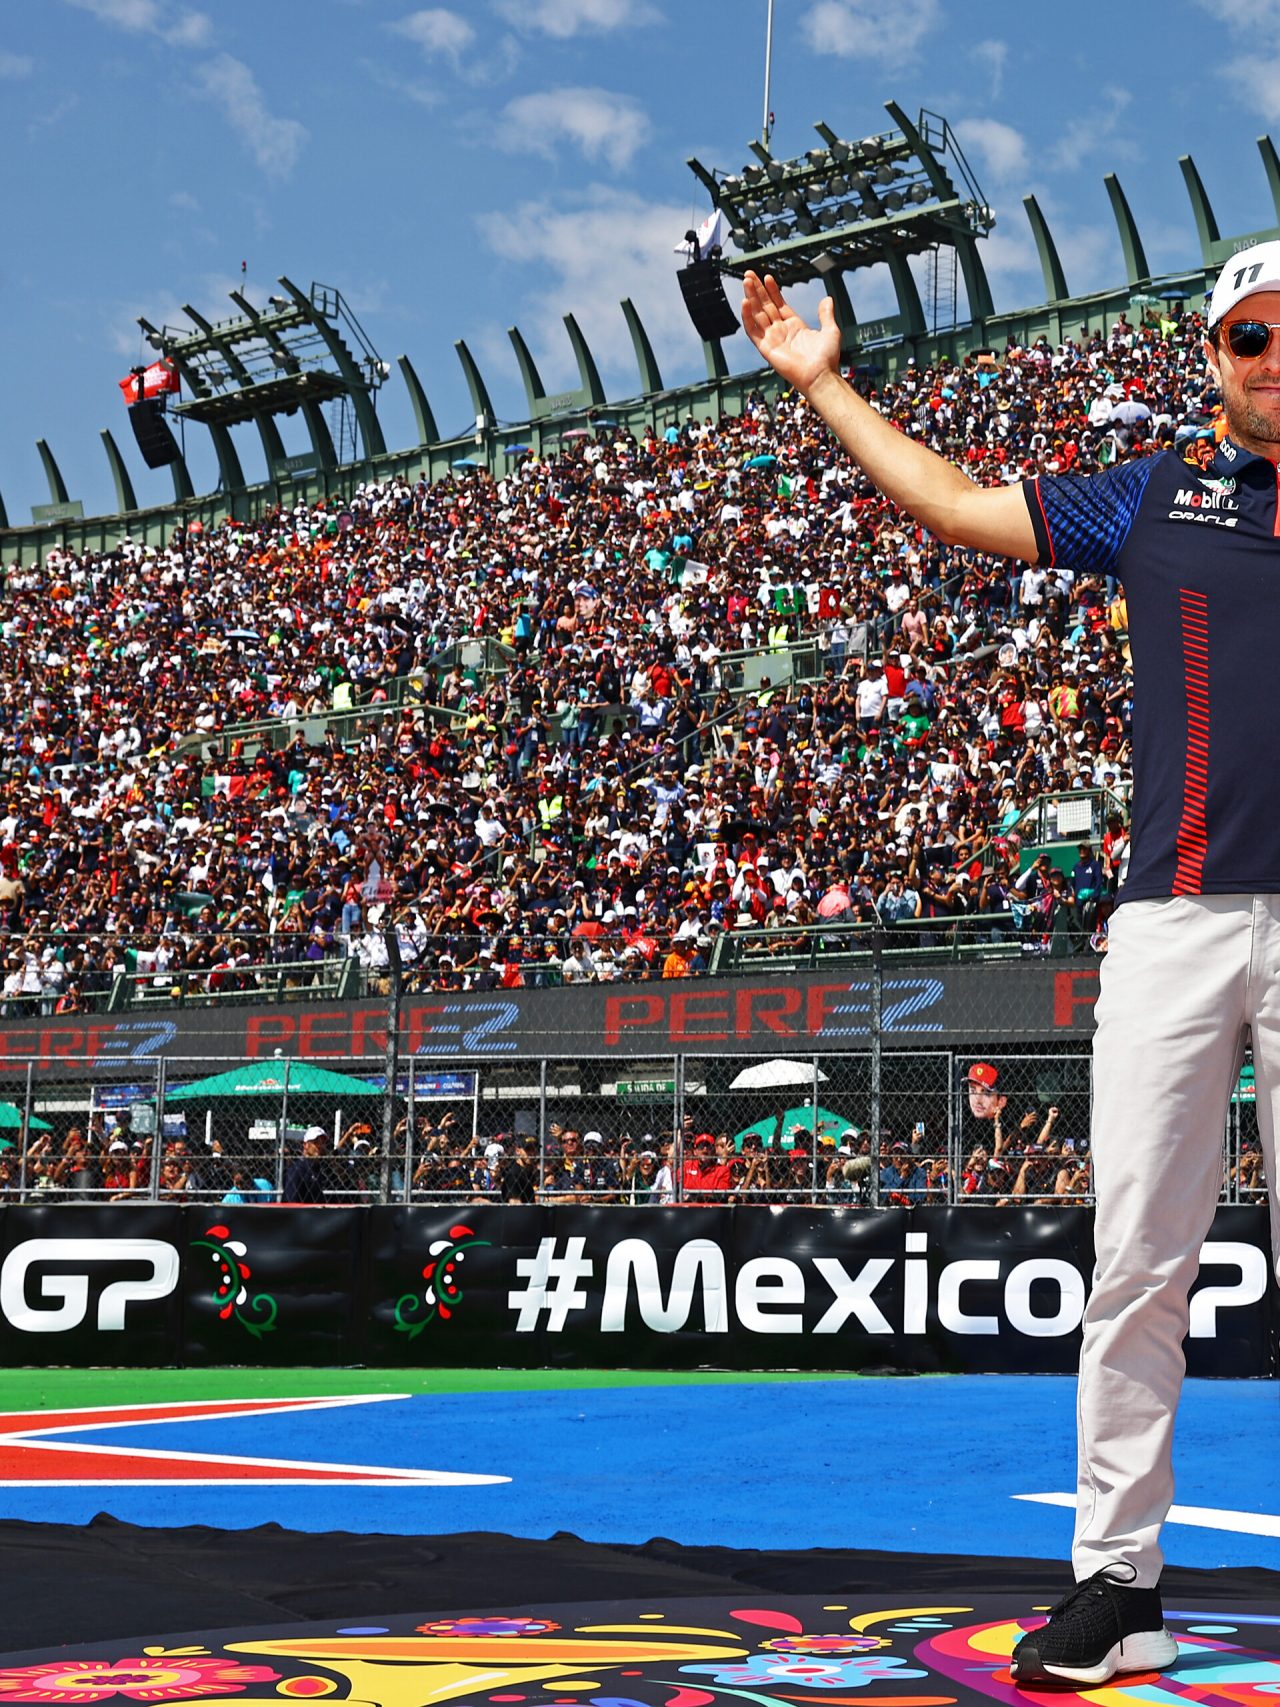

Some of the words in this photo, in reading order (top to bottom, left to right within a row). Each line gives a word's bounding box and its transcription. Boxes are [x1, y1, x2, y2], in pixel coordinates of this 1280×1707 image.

[1233, 263, 1264, 290] 11
[1168, 510, 1239, 527] ORACLE
[1173, 489, 1221, 509] Mobil
[244, 1002, 519, 1058] PEREZ
[604, 978, 944, 1046] PEREZ
[0, 1238, 180, 1332] GP
[507, 1232, 1268, 1339] #MexicoP
